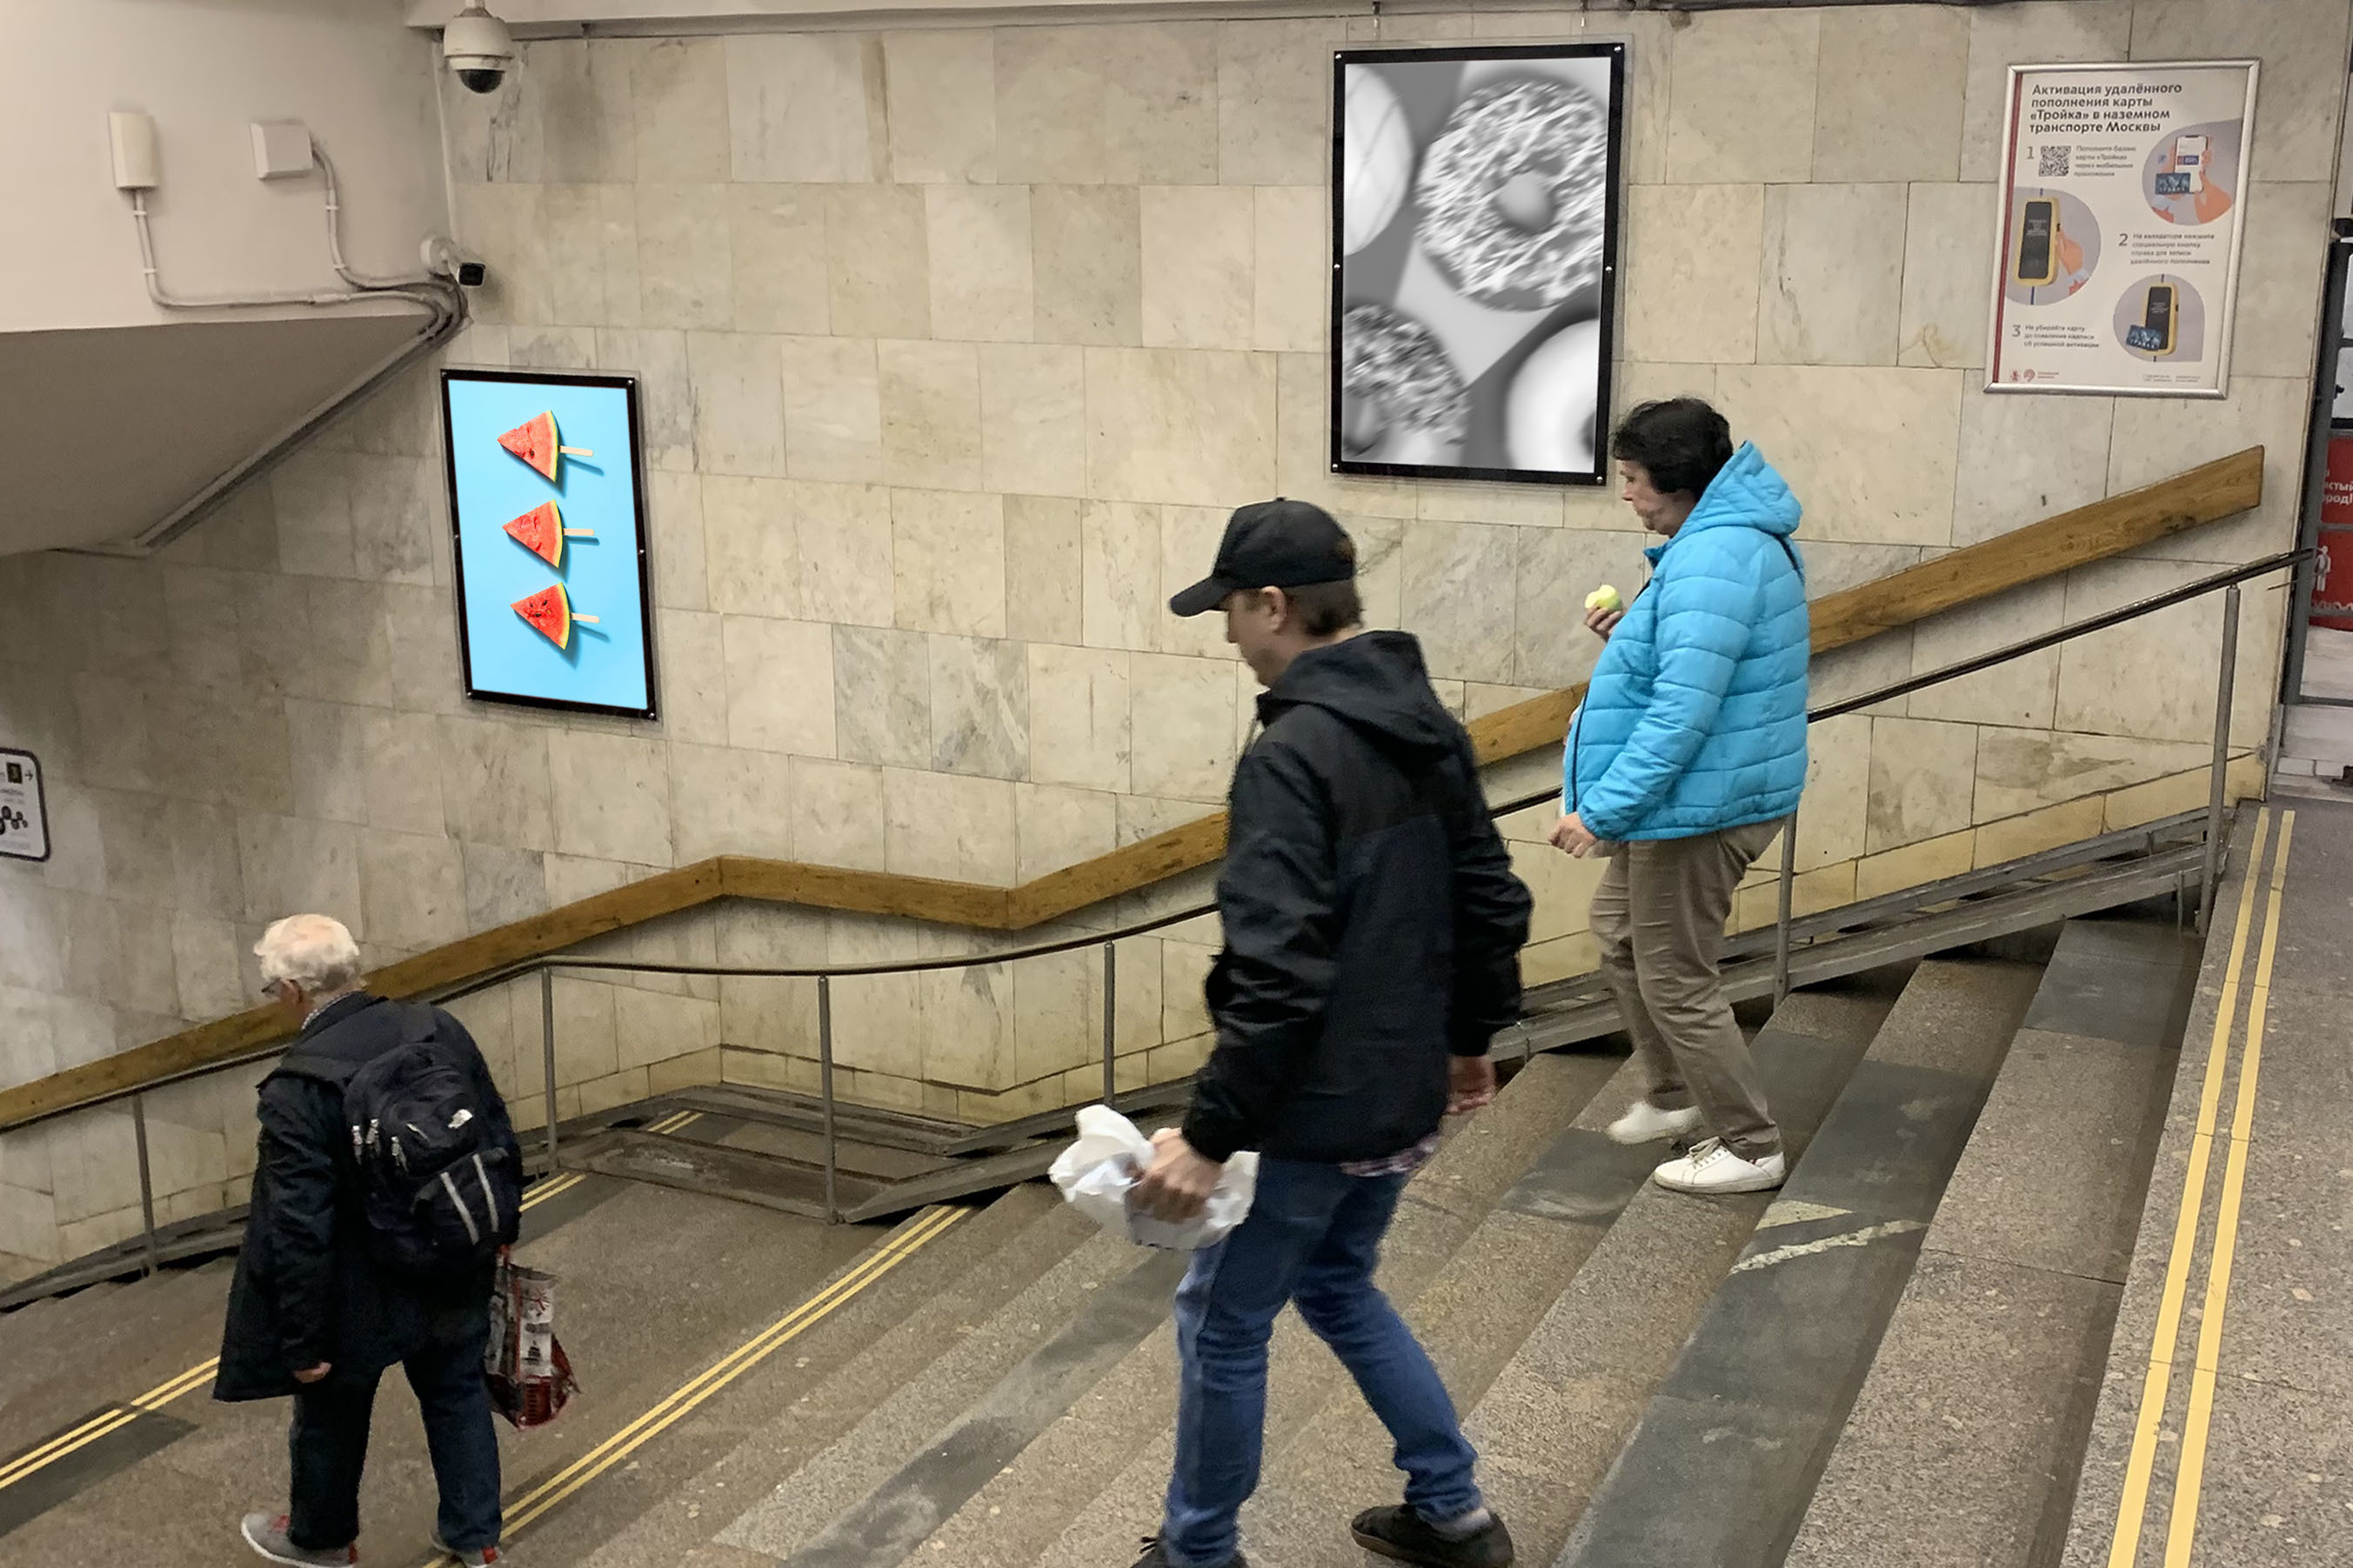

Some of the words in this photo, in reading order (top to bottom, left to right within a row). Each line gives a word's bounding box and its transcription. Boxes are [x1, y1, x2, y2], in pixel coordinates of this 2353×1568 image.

[2032, 84, 2102, 96] Активация
[2104, 83, 2183, 97] удалённого
[2031, 97, 2109, 108] пополнения
[2112, 97, 2154, 109] карты
[2030, 109, 2089, 122] «Тройка»
[2093, 111, 2101, 120] в
[2103, 110, 2170, 120] наземном
[2029, 122, 2103, 135] транспорте
[2105, 120, 2162, 132] Москвы
[2026, 146, 2035, 160] 1
[2118, 232, 2129, 247] 2
[2012, 324, 2022, 337] 3
